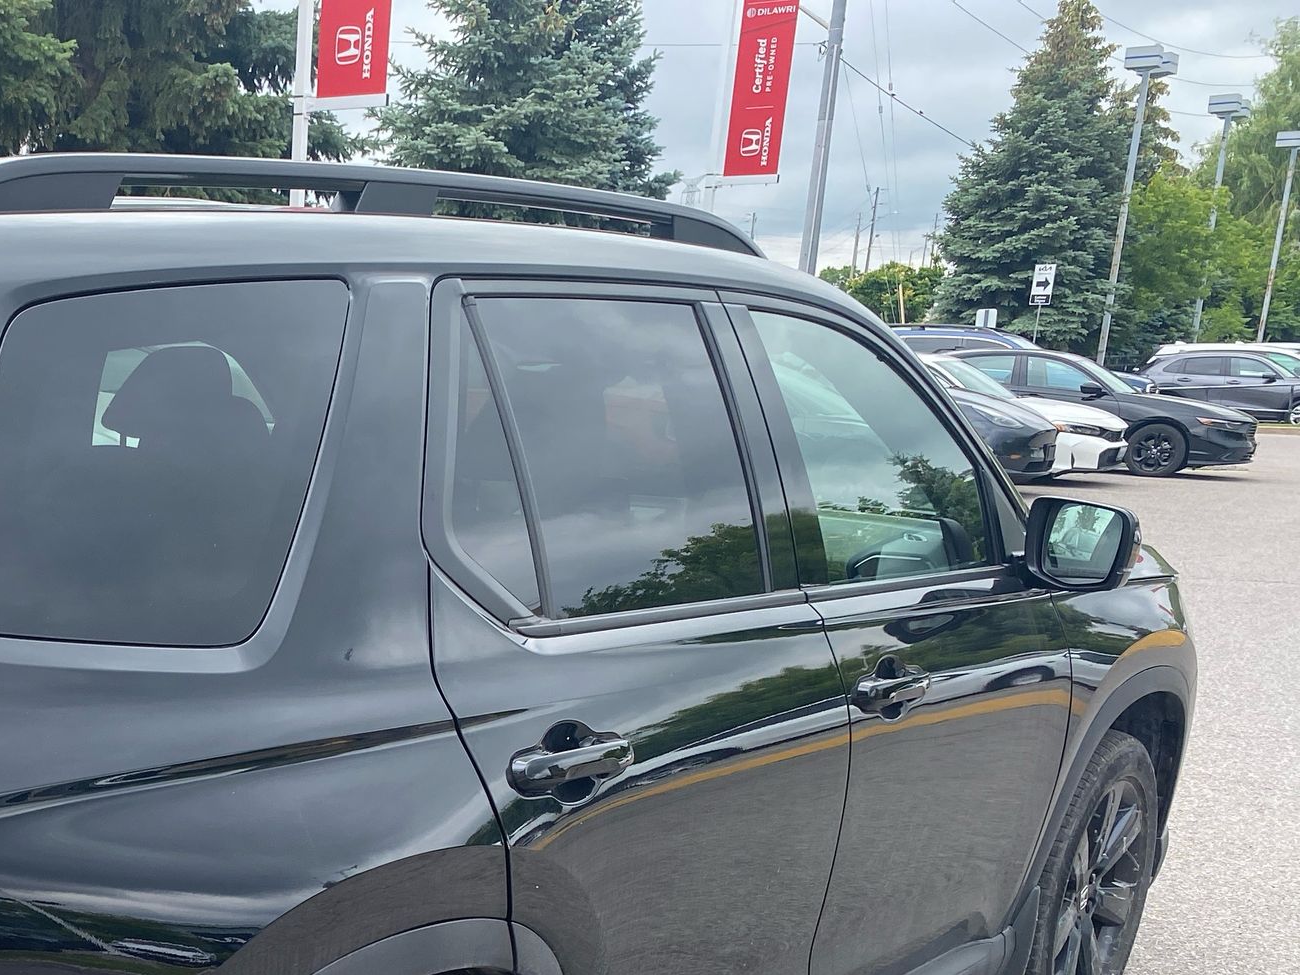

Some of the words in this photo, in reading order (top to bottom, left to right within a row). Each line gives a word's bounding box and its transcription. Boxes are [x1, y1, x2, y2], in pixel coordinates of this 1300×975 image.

[757, 5, 796, 16] DILAWRI
[362, 7, 375, 79] HONDA
[752, 38, 767, 93] Certified
[765, 37, 777, 92] PRE-OWNED
[760, 117, 773, 167] HONDA
